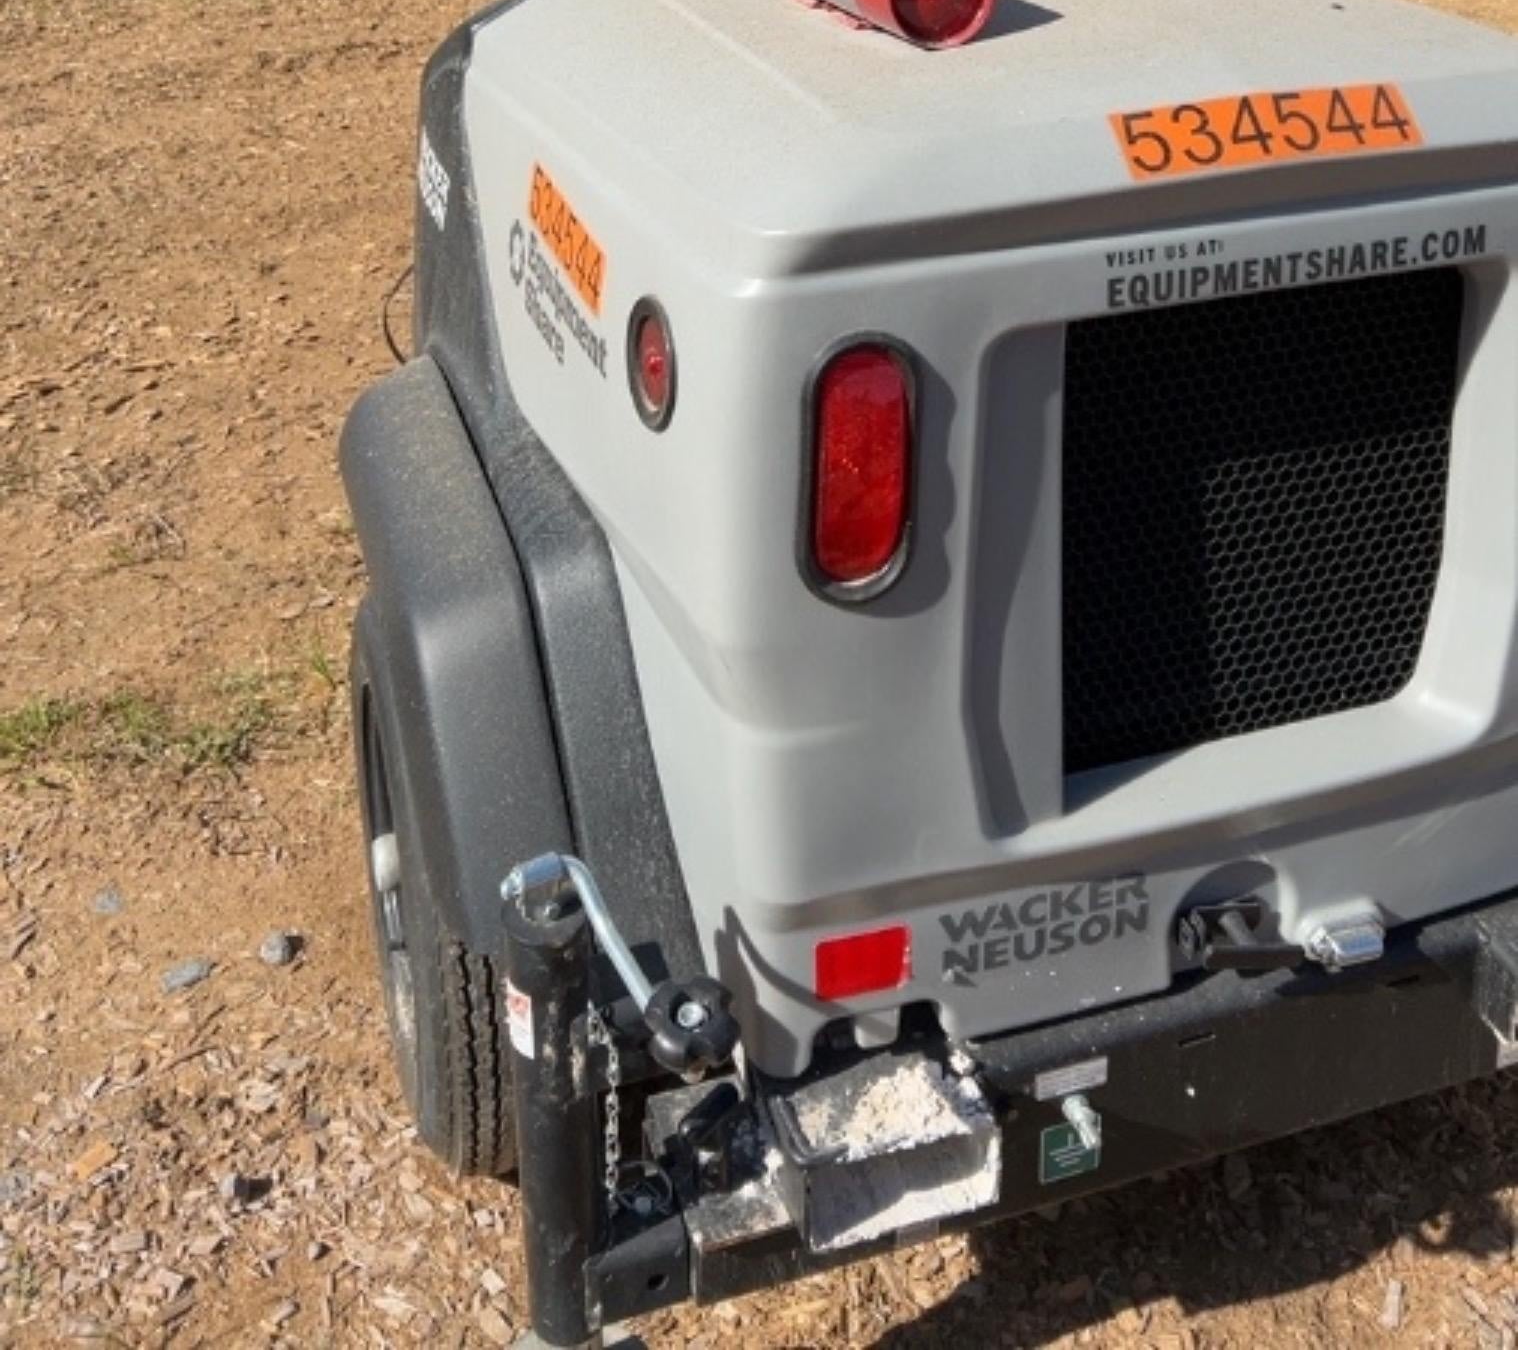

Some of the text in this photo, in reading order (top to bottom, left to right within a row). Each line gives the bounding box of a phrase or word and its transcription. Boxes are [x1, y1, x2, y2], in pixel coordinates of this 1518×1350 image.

[1120, 85, 1411, 173] 534544
[530, 163, 602, 300] 534544
[1105, 248, 1156, 268] VISIT
[1163, 242, 1188, 261] US
[1106, 224, 1487, 309] EQUIPMENTSHARE.COM
[527, 230, 608, 380] Equipment
[938, 874, 1150, 943] WACKER
[942, 902, 1150, 988] NEUSON
